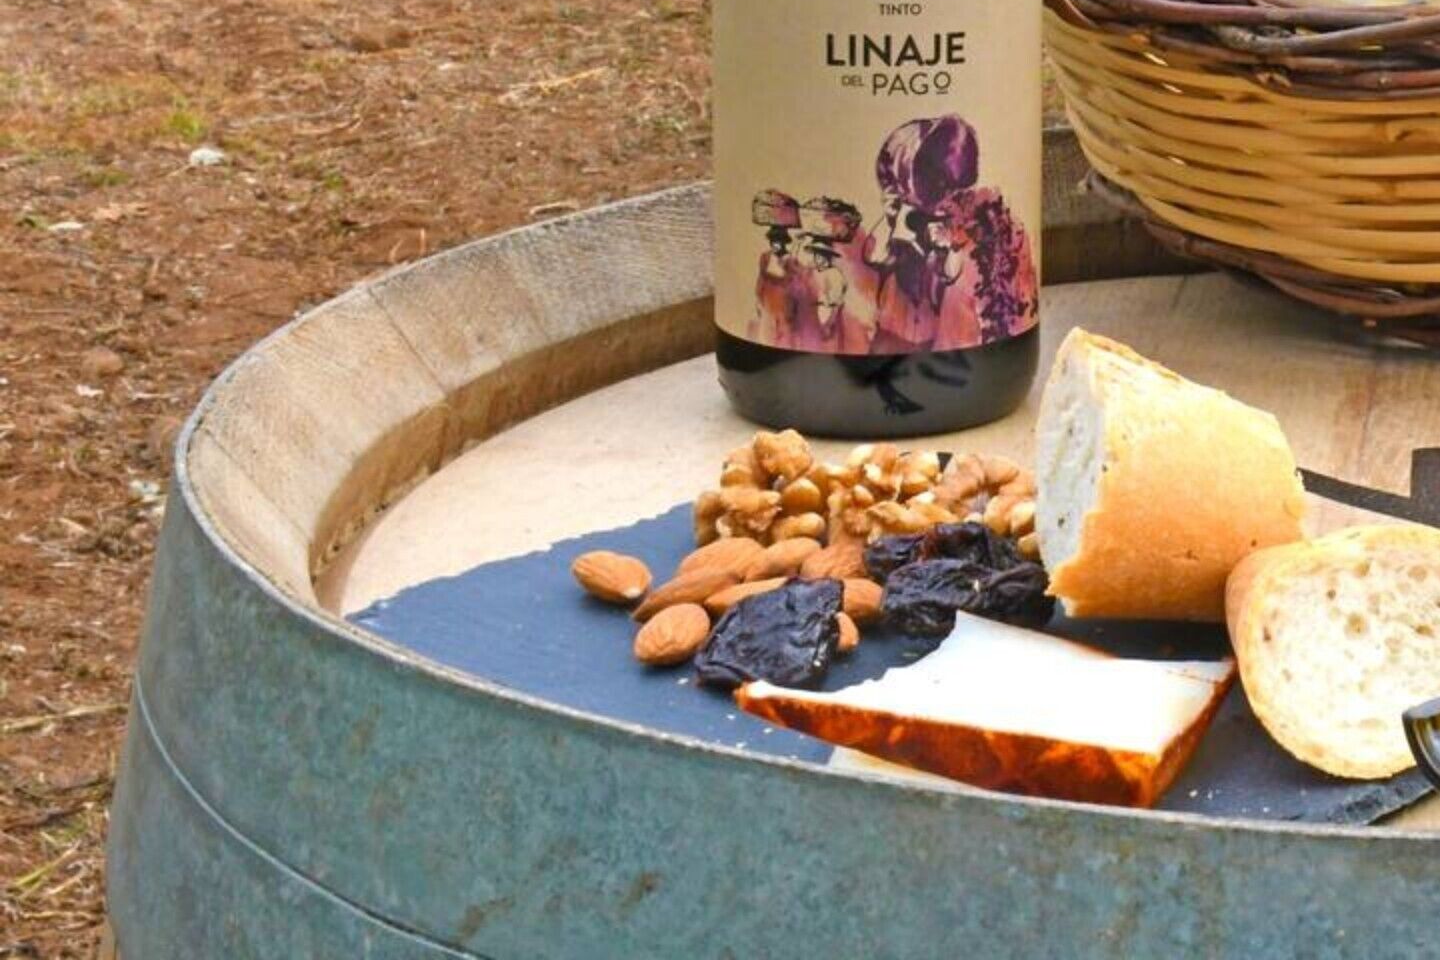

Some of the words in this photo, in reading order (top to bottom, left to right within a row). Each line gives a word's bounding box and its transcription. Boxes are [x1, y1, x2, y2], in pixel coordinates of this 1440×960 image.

[879, 3, 922, 16] TINTO
[826, 32, 966, 67] LINAJE
[841, 74, 864, 87] DEL
[872, 71, 952, 96] PAGO
